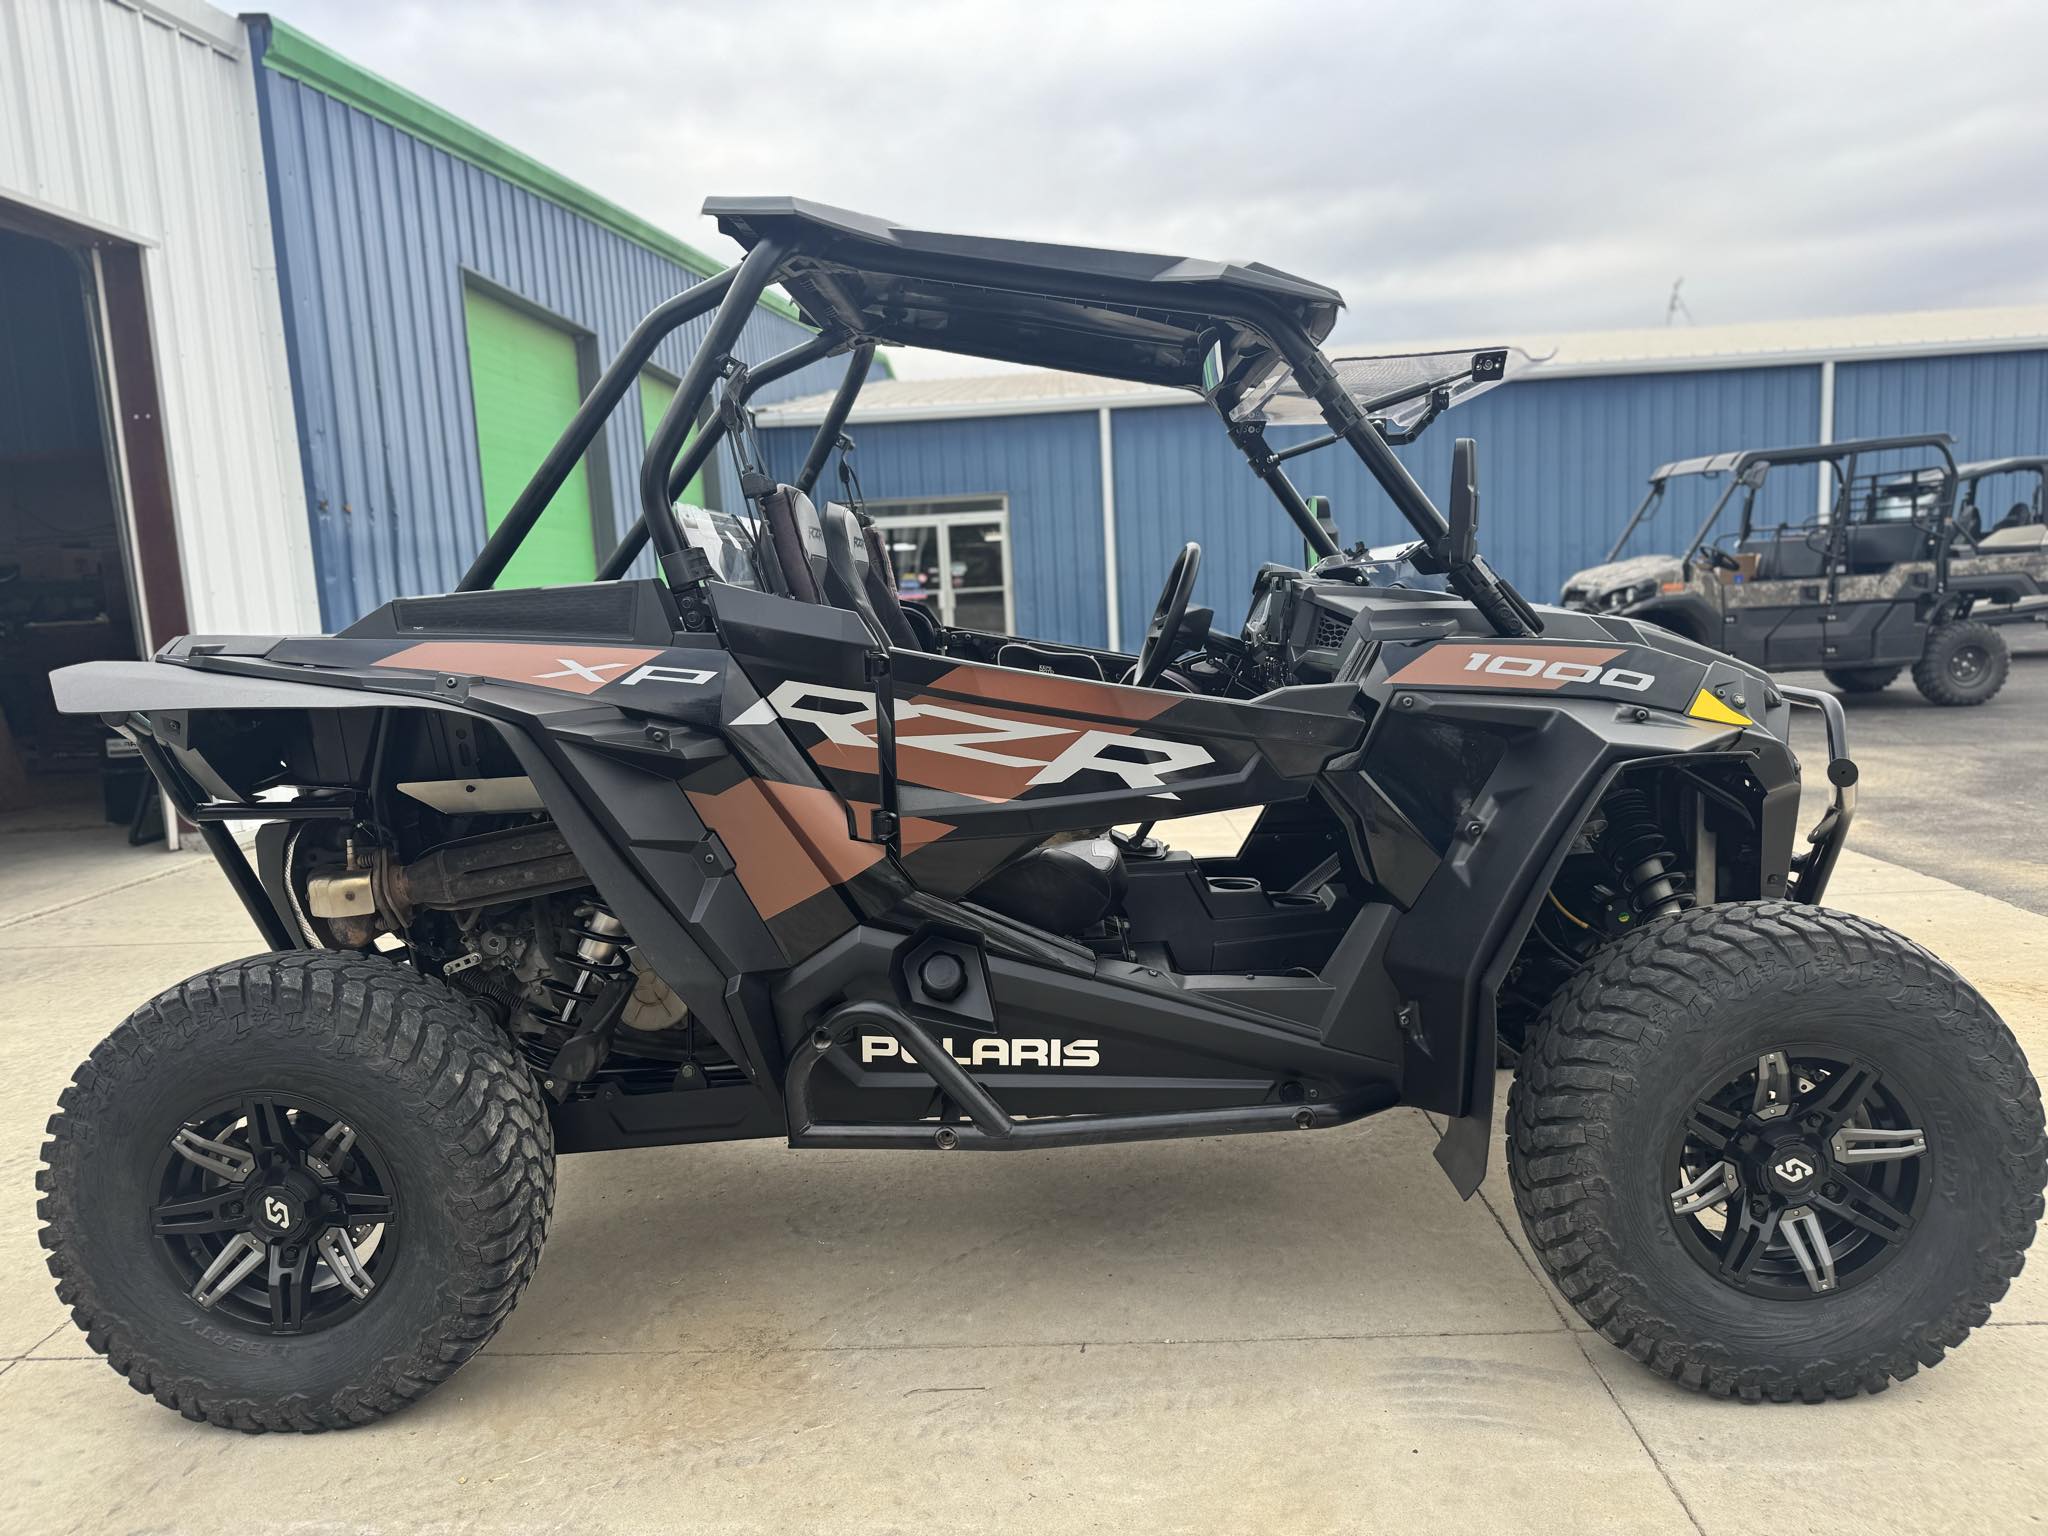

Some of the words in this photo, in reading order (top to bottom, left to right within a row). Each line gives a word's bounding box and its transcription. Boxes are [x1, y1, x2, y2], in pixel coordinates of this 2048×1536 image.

[530, 659, 719, 685] XP
[1464, 652, 1655, 691] 1000
[728, 680, 1215, 800] RZR
[180, 1317, 298, 1357] LIBERTY
